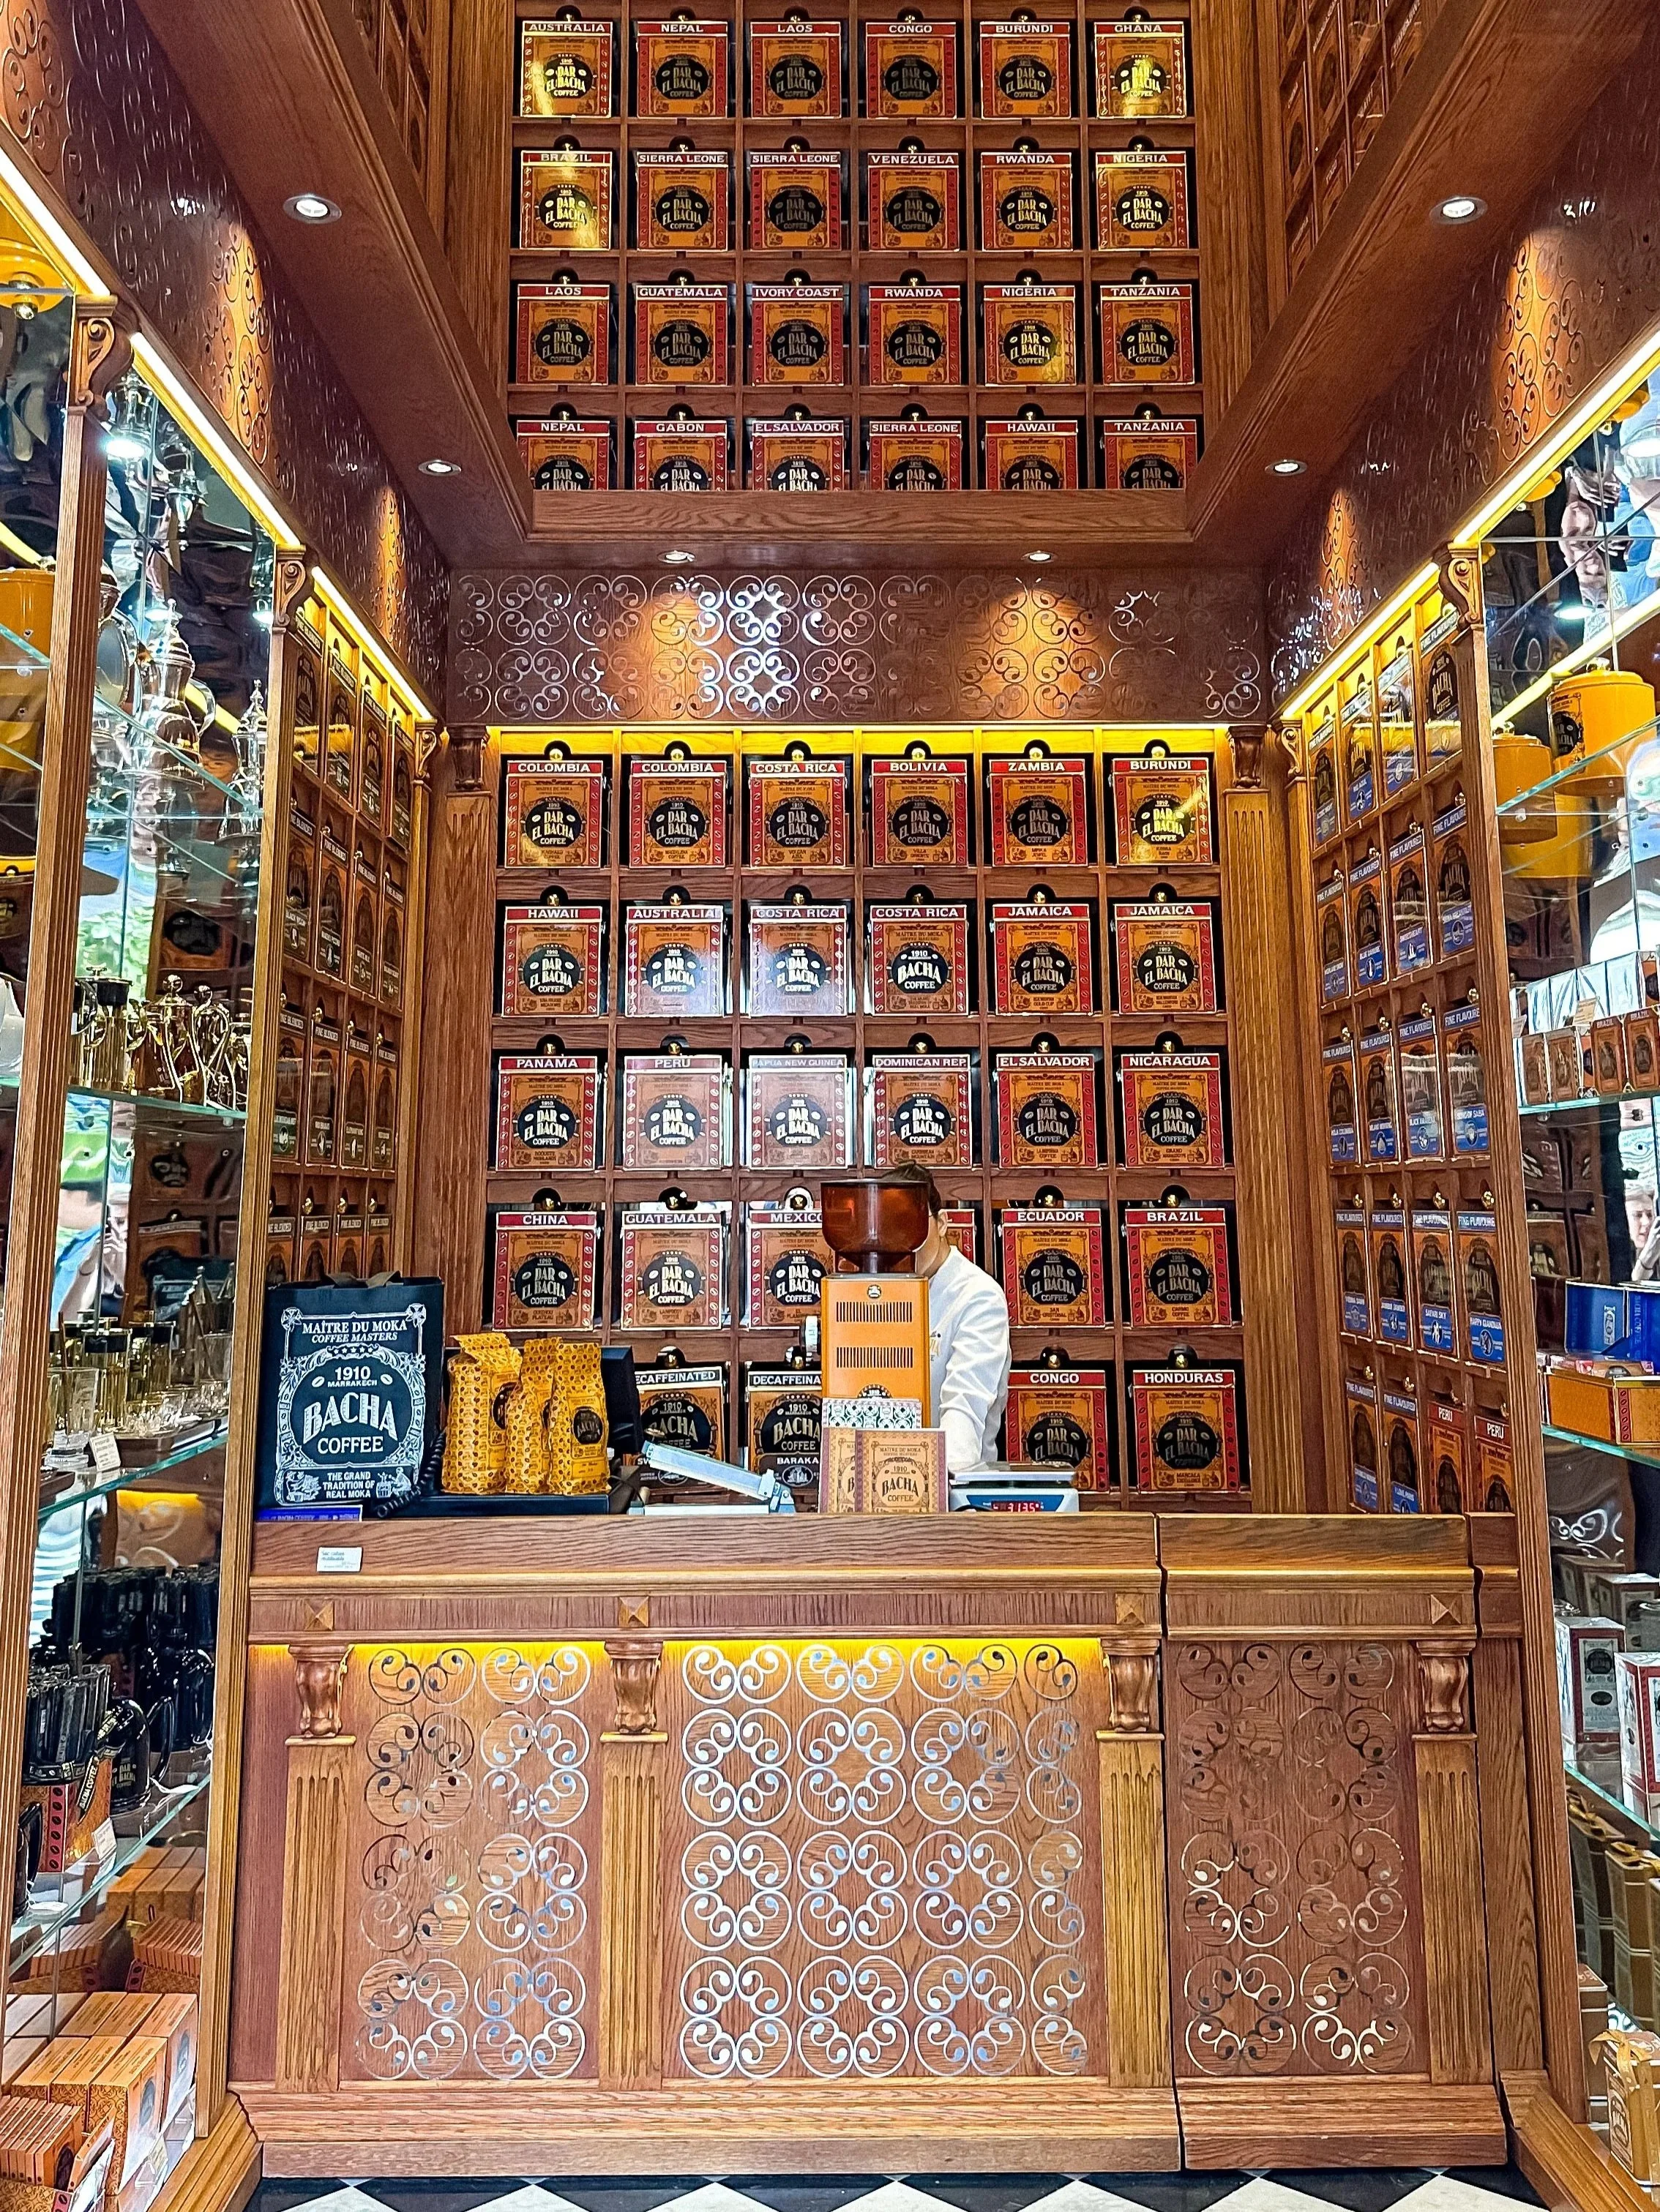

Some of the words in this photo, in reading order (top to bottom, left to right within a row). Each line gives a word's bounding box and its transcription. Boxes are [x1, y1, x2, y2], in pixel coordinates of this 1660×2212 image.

[529, 24, 605, 32] AUSTRALIA
[661, 24, 703, 33] NEPAL
[777, 24, 812, 33] LAOS
[889, 25, 932, 34] CONGO
[996, 25, 1053, 33] BURUNDI
[1115, 24, 1162, 33] GHANA
[541, 154, 591, 162] BRAZIL
[752, 155, 796, 163] SIERRA
[872, 156, 954, 165] VENEZUELA
[997, 155, 1054, 164] RWANDA
[1113, 154, 1167, 163] NIGERIA
[1134, 198, 1151, 209] DAR
[1124, 213, 1132, 225] EL
[1134, 209, 1162, 225] BACHA
[545, 287, 581, 296] LAOS
[640, 288, 722, 297] GUATEMALA
[755, 288, 793, 297] IVORY
[796, 288, 839, 297] COAST
[885, 288, 943, 297] RWANDA
[1001, 288, 1055, 296] NIGERIA
[1111, 287, 1180, 296] TANZANIA
[1138, 332, 1156, 343] DAR
[1128, 346, 1136, 359] EL
[1138, 342, 1167, 359] BACHA
[541, 423, 584, 432] NEPAL
[656, 424, 703, 432] GABON
[872, 423, 916, 432] SIERRA
[920, 424, 957, 432] LEONE
[1008, 423, 1055, 432] HAWAII
[1115, 422, 1184, 431] TANZANIA
[518, 763, 590, 772] COLOMBIA
[642, 762, 714, 772] COLOMBIA
[756, 764, 800, 773] COSTA
[807, 763, 837, 773] RICA
[890, 763, 947, 771] BOLIVIA
[1009, 762, 1064, 771] ZAMBIA
[1130, 761, 1191, 770] BURUNDI
[544, 811, 564, 823] DAR
[533, 827, 542, 840] EL
[543, 822, 574, 841] BACHA
[528, 909, 578, 918] HAWAII
[633, 909, 713, 918] AUSTRALIA
[757, 909, 802, 918] COSTA
[807, 909, 839, 918] RICA
[876, 909, 921, 918] COSTA
[927, 908, 958, 917] RICA
[1009, 907, 1072, 916] JAMAICA
[1130, 906, 1194, 915] JAMAICA
[542, 958, 561, 970] DAR
[898, 961, 941, 981] BACHA
[531, 975, 540, 988] EL
[542, 971, 572, 987] BACHA
[538, 985, 564, 993] COFFEE
[905, 981, 935, 989] COFFEE
[1631, 1011, 1649, 1020] BRAZIL
[1596, 1019, 1613, 1028] BRAZIL
[517, 1059, 577, 1068] PANAMA
[654, 1058, 690, 1068] PERU
[875, 1057, 941, 1067] DOMINICAN
[944, 1058, 966, 1067] REP.
[1130, 1056, 1210, 1066] NICARAGUA
[537, 1109, 557, 1122] DAR
[913, 1109, 932, 1120] DAR
[525, 1126, 534, 1140] EL
[536, 1122, 567, 1139] BACHA
[902, 1125, 911, 1139] EL
[913, 1120, 944, 1138] BACHA
[533, 1137, 559, 1145] COFFEE
[523, 1215, 567, 1225] CHINA
[626, 1214, 716, 1223] GUATEMALA
[1017, 1211, 1084, 1221] ECUADOR
[1148, 1211, 1203, 1221] BRAZIL
[662, 1267, 681, 1279] DAR
[649, 1283, 659, 1297] EL
[662, 1279, 693, 1297] BACHA
[658, 1295, 684, 1303] COFFEE
[302, 1320, 348, 1334] MAÎTRE
[352, 1321, 369, 1332] DU
[373, 1319, 407, 1330] MOKA
[312, 1334, 348, 1343] COFFEE
[351, 1332, 397, 1341] MASTERS
[334, 1367, 370, 1380] 1910
[635, 1371, 715, 1384] ECAFFEINATED
[1030, 1373, 1079, 1383] CONGO
[1145, 1373, 1223, 1383] HONDURAS
[663, 1403, 682, 1411] 1910
[789, 1403, 807, 1412] 1910
[303, 1392, 397, 1444] BACHA
[1439, 1407, 1452, 1421] PERU
[773, 1418, 821, 1444] BACHA
[1487, 1423, 1503, 1439] PERU
[318, 1436, 383, 1453] COFFEE
[781, 1441, 815, 1450] COFFEE
[344, 1471, 370, 1480] GRAND
[323, 1481, 362, 1490] TRADITION
[364, 1480, 375, 1488] OF
[882, 1476, 919, 1497] BACHA
[326, 1490, 344, 1499] REAL
[348, 1490, 370, 1498] MOKA
[80, 1788, 91, 1808] BACHA
[86, 1765, 97, 1789] COFFEE
